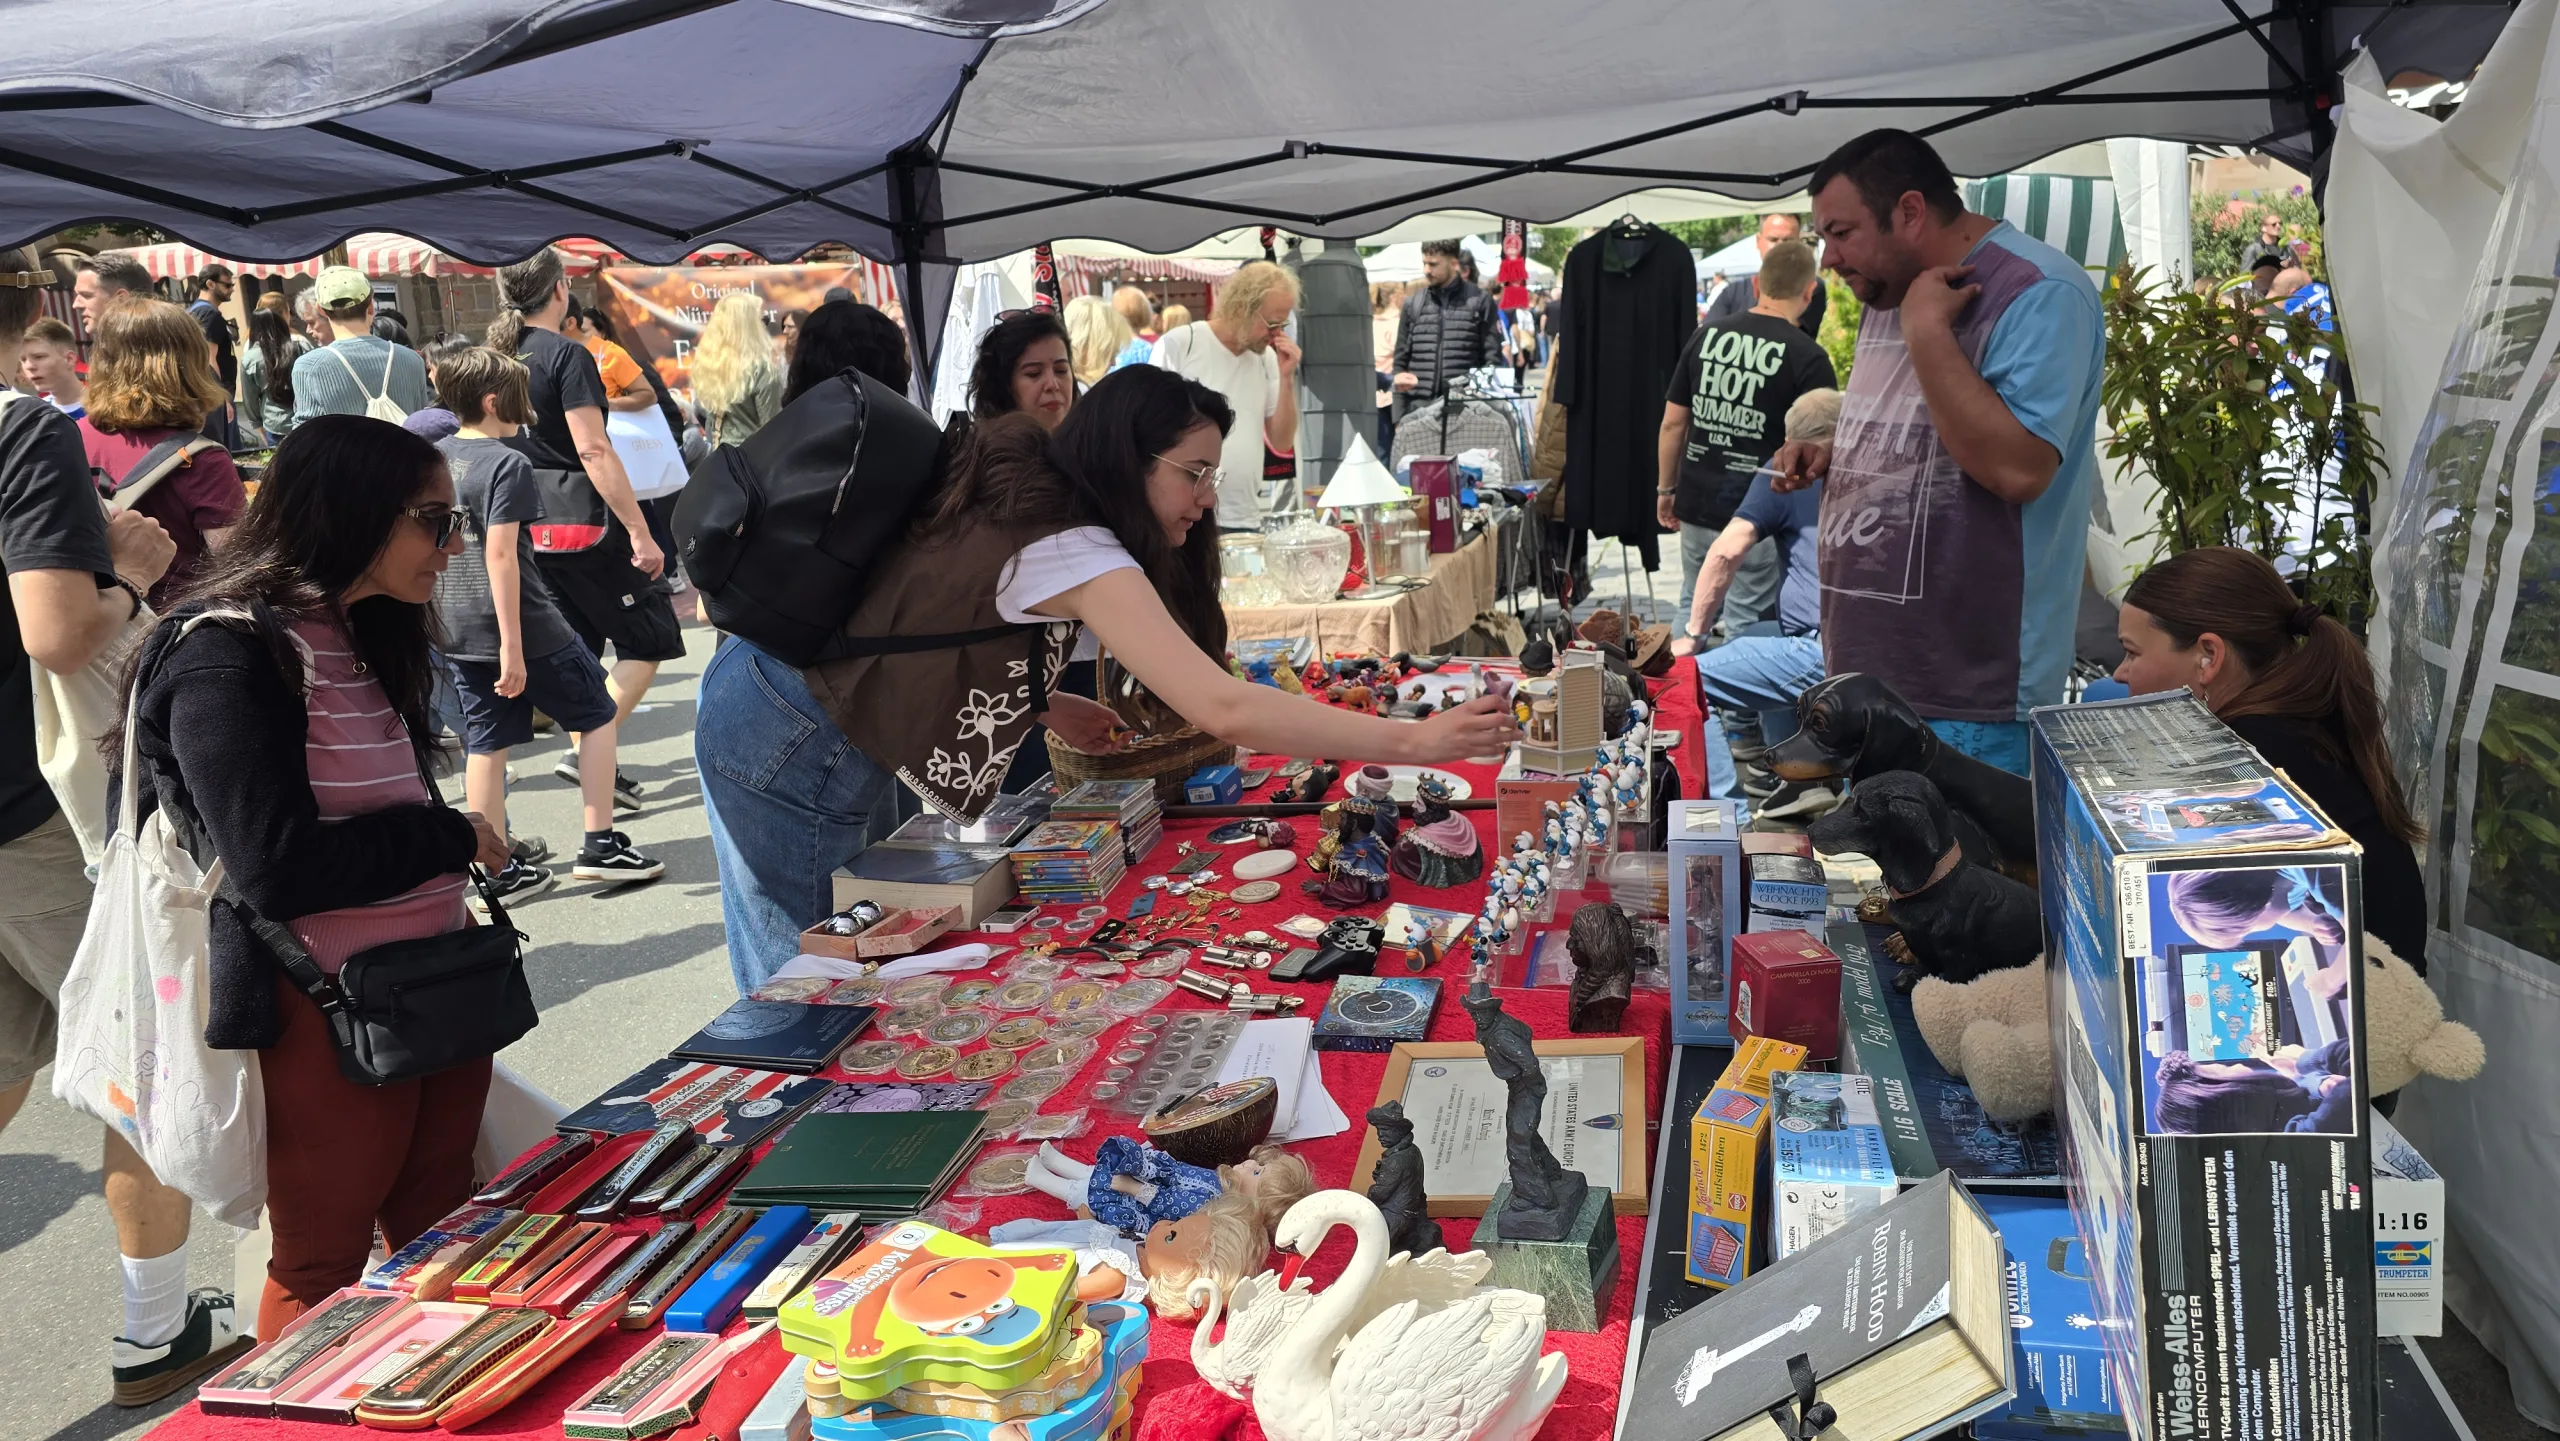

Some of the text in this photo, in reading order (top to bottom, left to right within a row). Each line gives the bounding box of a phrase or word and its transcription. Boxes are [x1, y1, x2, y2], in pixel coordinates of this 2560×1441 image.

[1699, 328, 1786, 376] LONG
[1699, 361, 1765, 406] HOT
[1692, 395, 1766, 433] SUMMER
[1708, 433, 1732, 446] U.S.A.
[1756, 884, 1825, 896] WEIHNACHTS-
[1760, 895, 1818, 905] GLOCKE 1993
[2134, 875, 2143, 905] 170/451
[1846, 943, 1870, 966] 1942
[1771, 971, 1809, 979] CAMPANELLA
[1842, 964, 1873, 999] model
[2265, 1002, 2274, 1039] BUCHSTABIERT
[1855, 1079, 1870, 1095] ELITE
[1562, 1083, 1578, 1167] UNITED STATES EUROPE
[1883, 1076, 1919, 1140] 1:16 SCALE
[1698, 1132, 1709, 1152] 1472
[1866, 1128, 1884, 1180] INNENFILTER
[2223, 1150, 2234, 1169] den
[1714, 1137, 1726, 1205] Laufställchen
[2223, 1171, 2238, 1212] spielend
[2227, 1215, 2240, 1261] Vermittelt
[2378, 1212, 2428, 1230] 1:16
[1868, 1219, 1891, 1341] ROBIN HOOD
[2378, 1268, 2428, 1279] TRUMPETER
[2205, 1157, 2232, 1439] TV-Gerät zu einem faszinierenden SPIEL- und LERNSYSTEM
[2230, 1264, 2243, 1331] entscheidend.
[2190, 1295, 2210, 1438] LERNCOMPUTER
[2234, 1332, 2246, 1366] Kindes
[2236, 1368, 2247, 1385] des
[2252, 1368, 2263, 1440] dem Computer.
[2268, 1358, 2283, 1437] Grundaktivitäten
